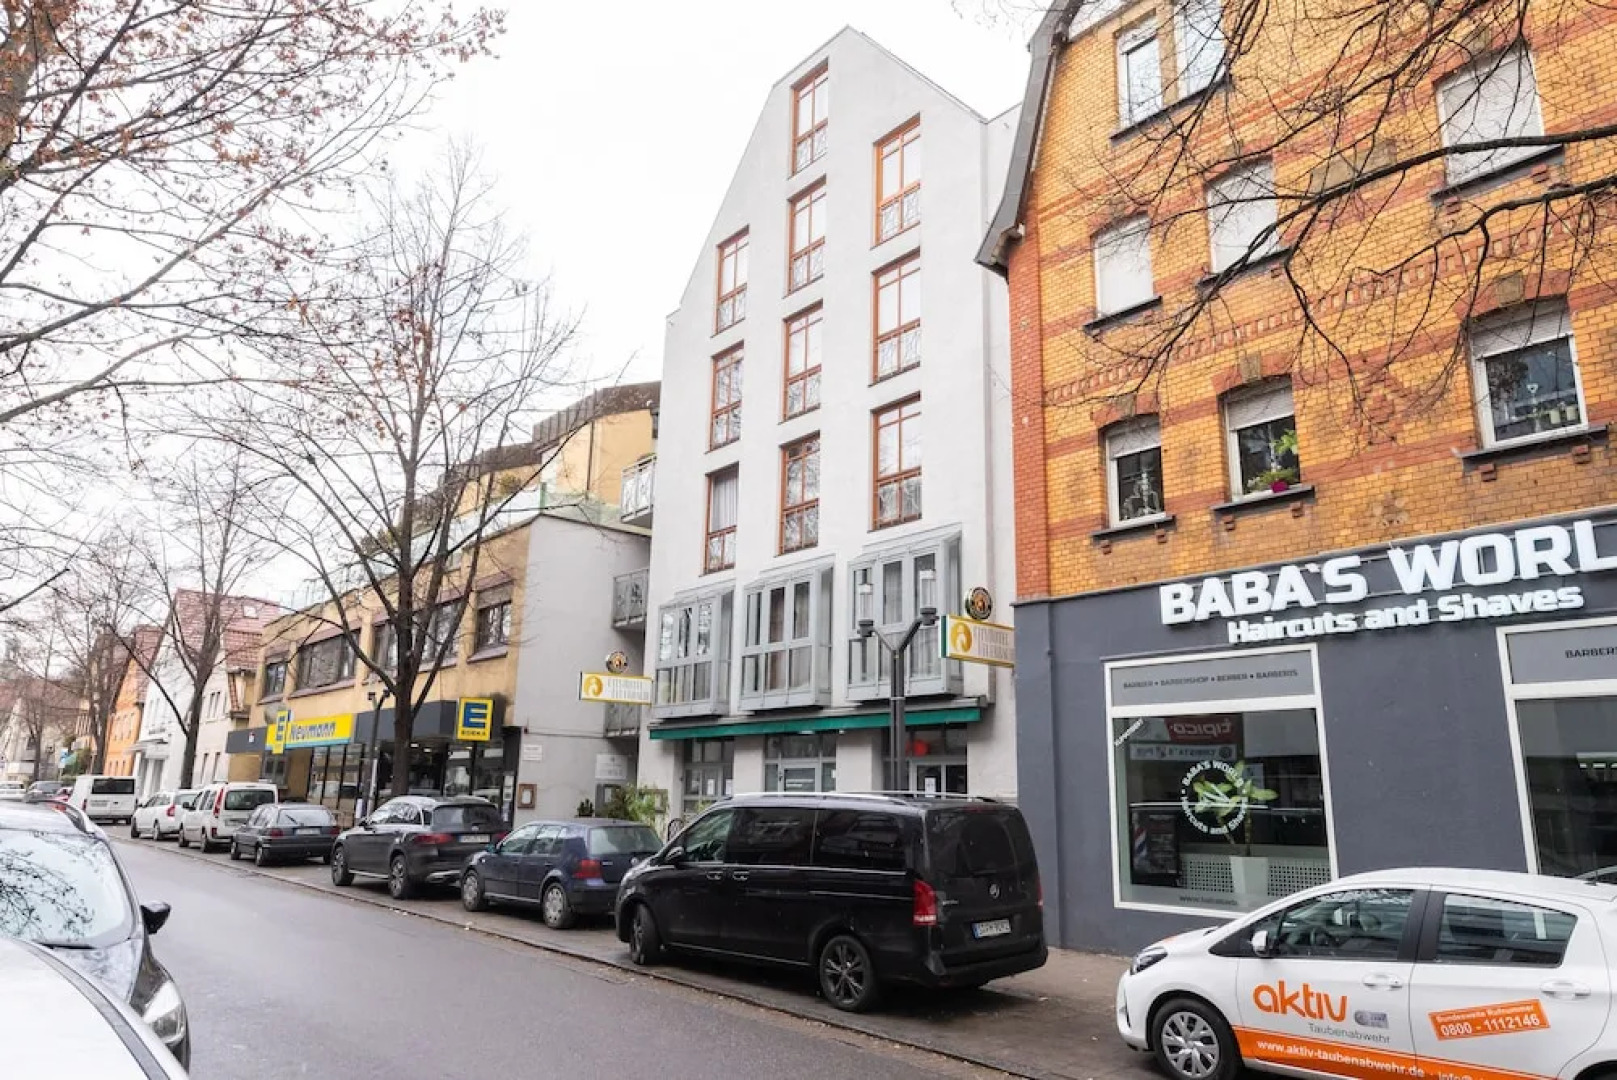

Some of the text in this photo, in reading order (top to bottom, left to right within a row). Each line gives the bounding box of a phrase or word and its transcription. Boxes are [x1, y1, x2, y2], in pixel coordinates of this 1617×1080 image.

[1227, 586, 1584, 643] Haircuts and Shaves
[1565, 646, 1617, 658] BARBER
[291, 722, 336, 741] Neumann
[1253, 979, 1347, 1023] aktiv
[1308, 1022, 1390, 1043] Taubenabwehr
[1440, 1021, 1473, 1037] 0800
[1484, 1013, 1540, 1032] 1112146
[1256, 1040, 1425, 1078] www.aktiv-taubenabwehr.de
